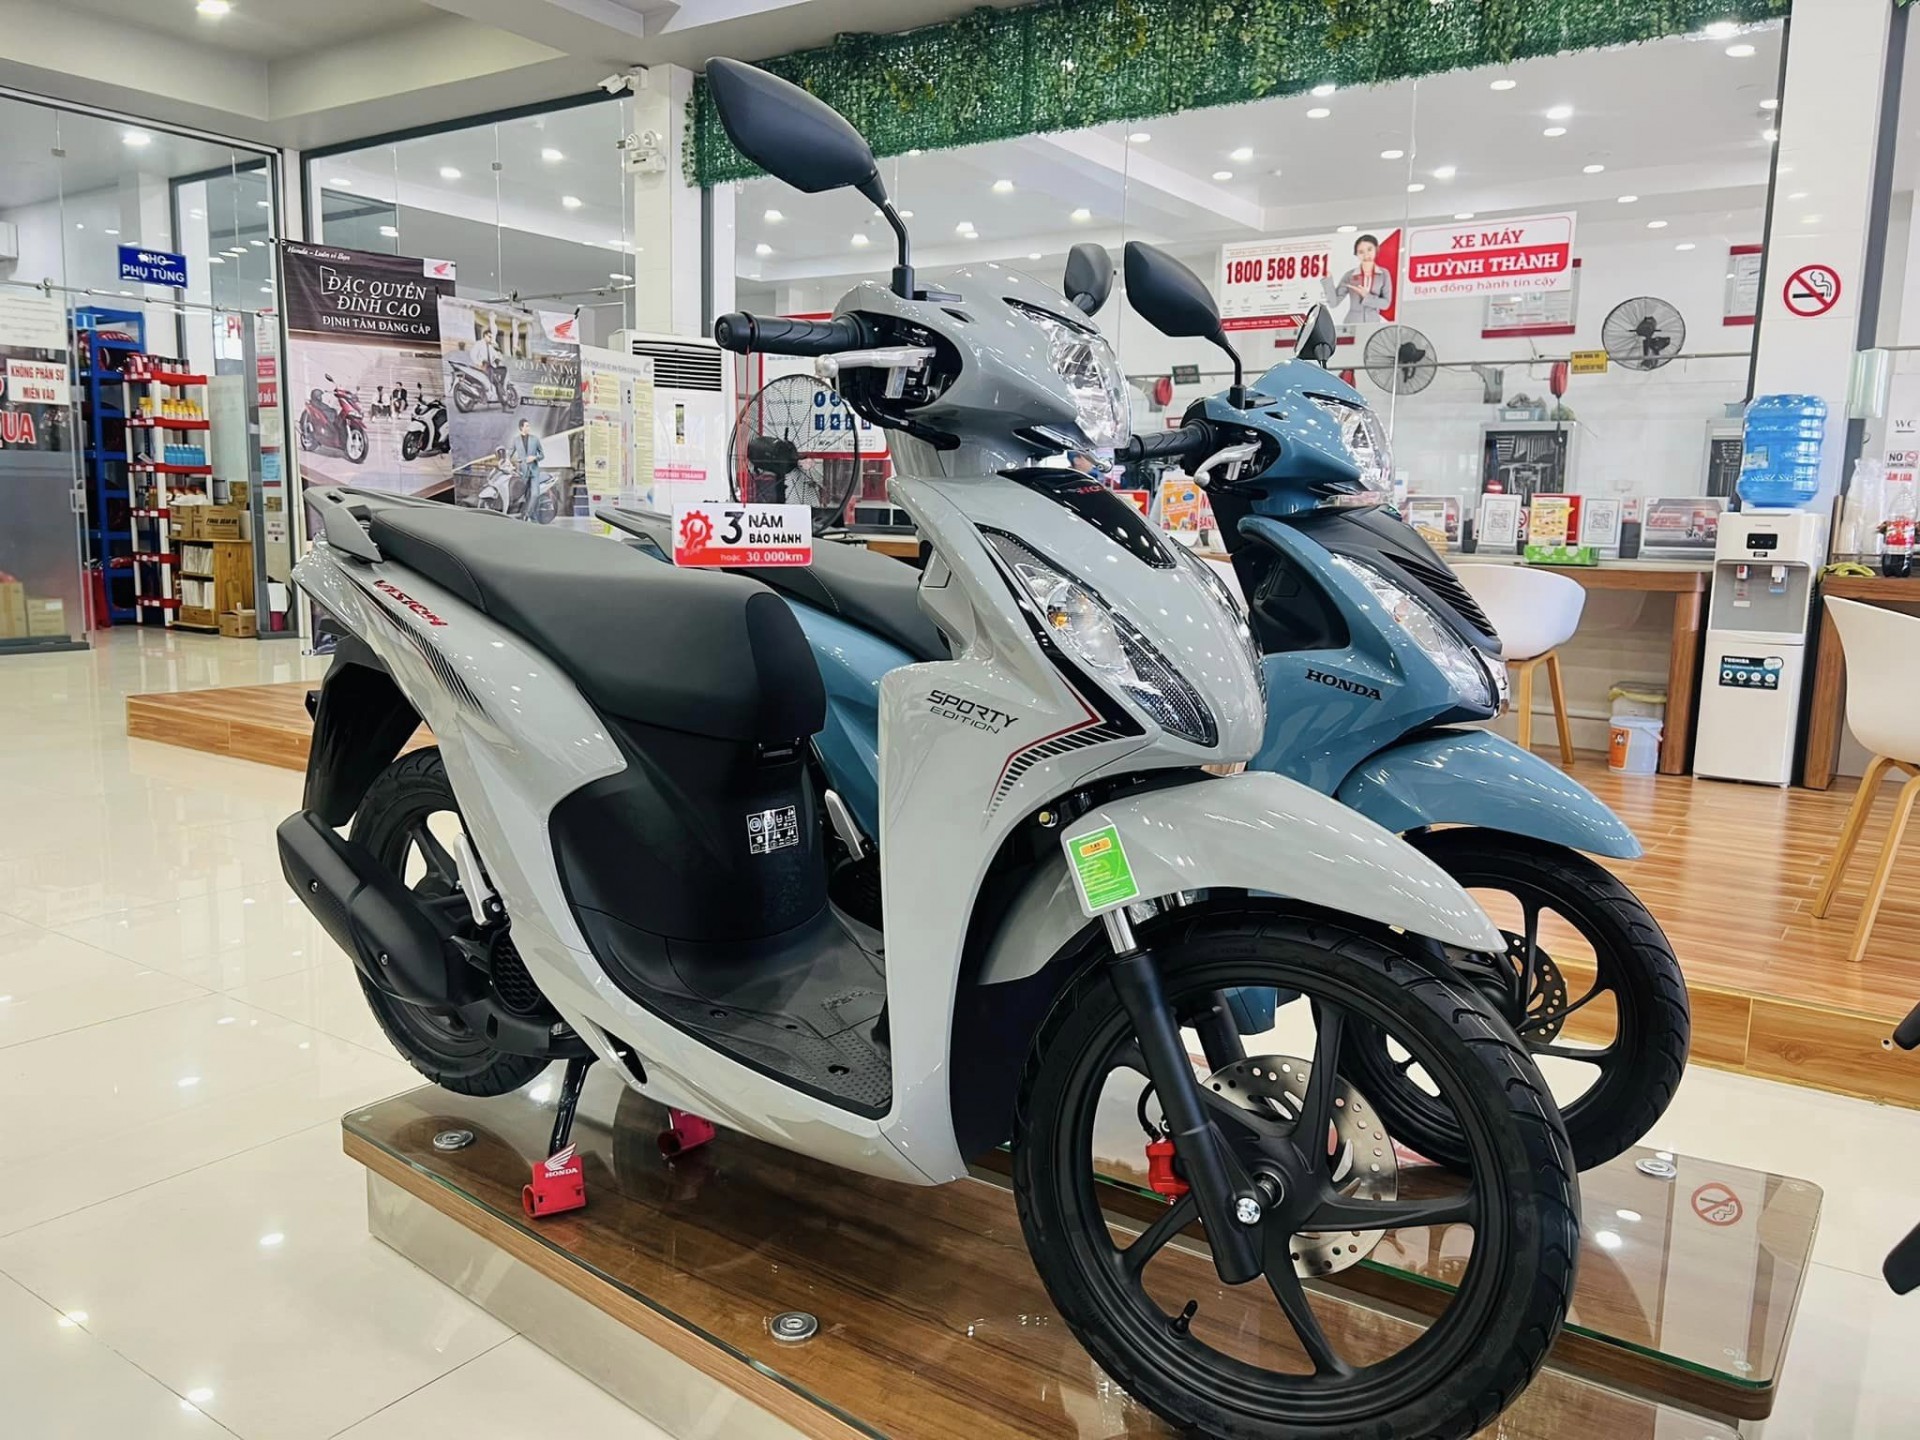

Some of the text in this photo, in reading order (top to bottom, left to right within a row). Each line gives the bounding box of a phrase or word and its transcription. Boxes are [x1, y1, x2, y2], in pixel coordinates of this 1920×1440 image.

[1451, 227, 1524, 249] XE MÁY
[122, 263, 185, 282] PHỤ TÙNG
[1227, 253, 1329, 285] 1800 588 861
[1415, 252, 1560, 279] HUỲNH THÀNH
[328, 275, 365, 296] ĐẶC
[1414, 284, 1438, 295] Bạn
[1477, 278, 1510, 289] hành
[386, 301, 421, 317] CAO
[322, 315, 350, 328] ĐỊNH
[0, 411, 36, 448] UA
[1889, 452, 1903, 462] NO
[720, 511, 783, 545] 3 NĂM
[746, 551, 804, 562] 30.000km
[373, 579, 448, 626] VISION
[1304, 668, 1382, 701] HONDA
[925, 689, 1019, 728] SPORTY
[929, 706, 1000, 734] EDITION
[544, 1167, 578, 1179] HONDA
